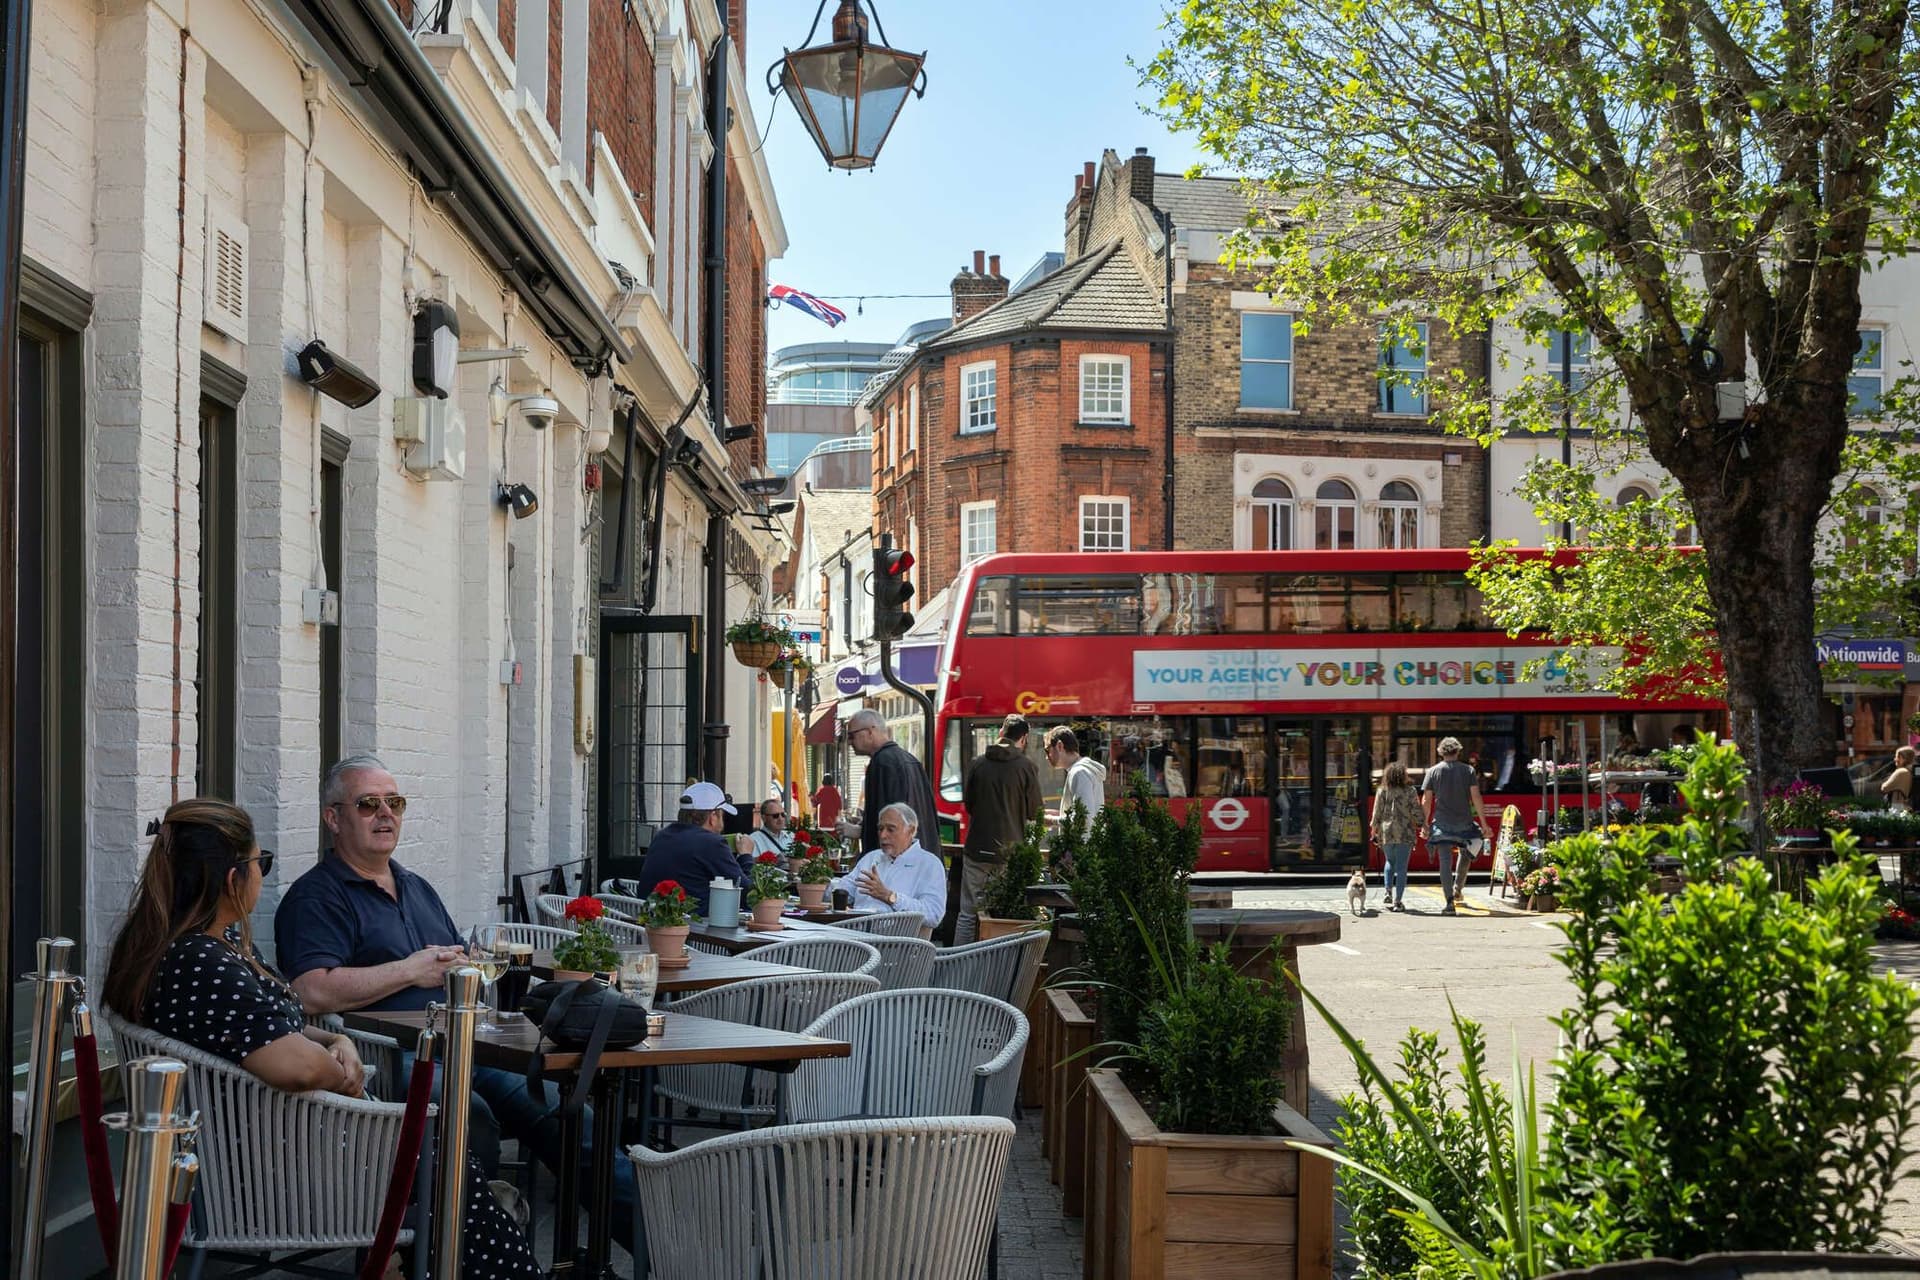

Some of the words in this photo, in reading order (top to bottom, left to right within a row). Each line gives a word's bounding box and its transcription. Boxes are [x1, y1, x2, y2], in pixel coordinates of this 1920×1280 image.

[1817, 646, 1900, 663] Nationwide
[838, 676, 860, 684] haart
[1148, 668, 1203, 684] YOUR
[1208, 667, 1292, 683] AGENCY
[1296, 662, 1386, 686] YOUR
[1394, 661, 1515, 686] CHOICE
[1015, 691, 1050, 714] Go
